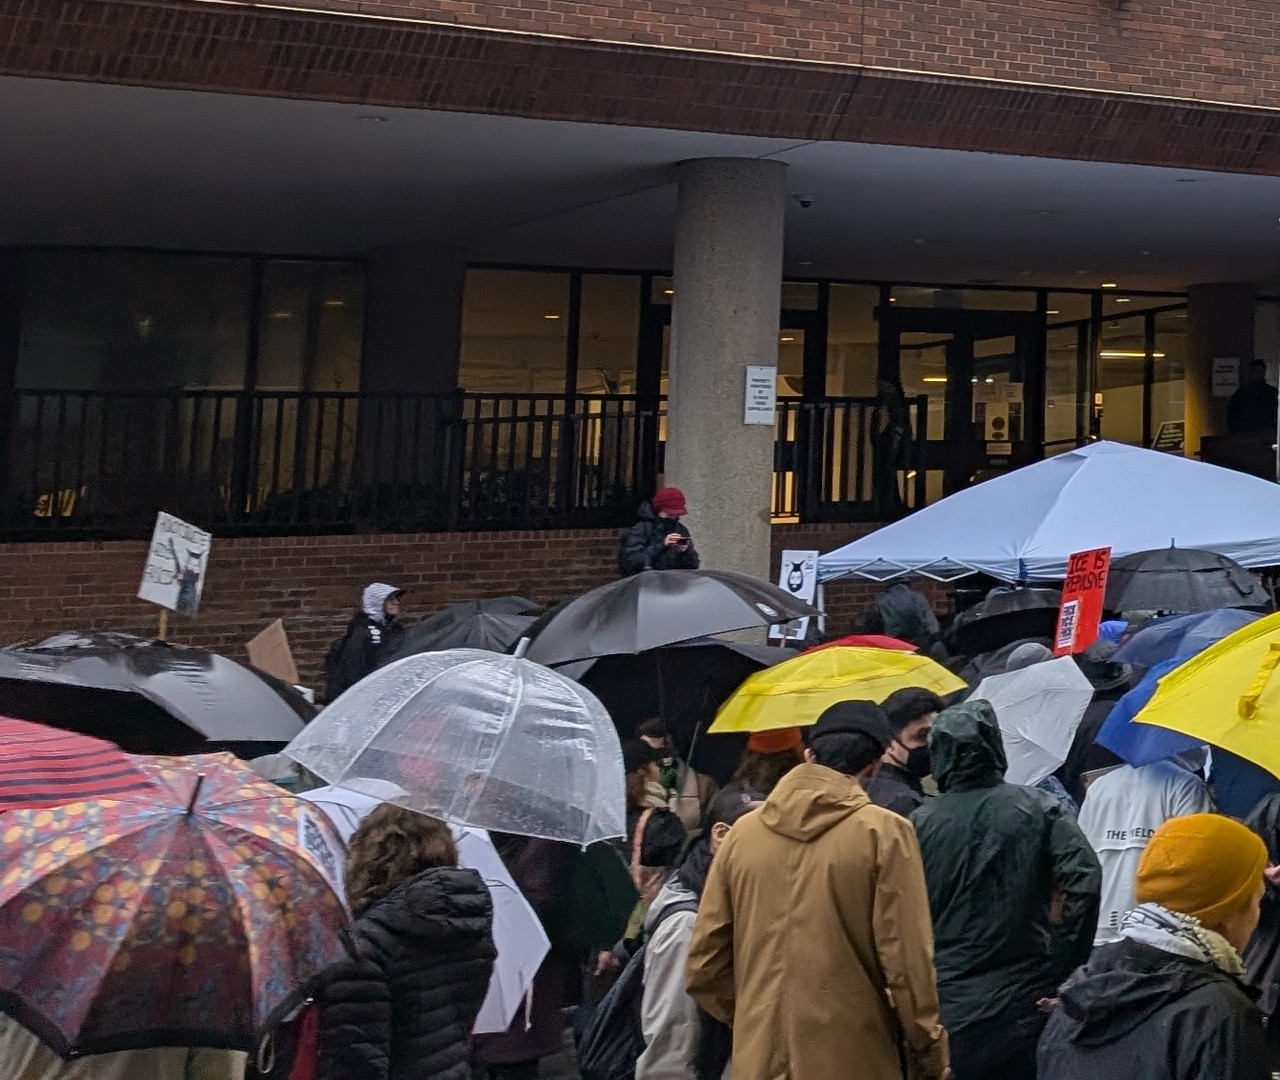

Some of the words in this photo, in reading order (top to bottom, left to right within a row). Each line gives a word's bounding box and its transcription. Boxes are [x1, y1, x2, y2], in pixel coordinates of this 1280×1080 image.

[1068, 553, 1089, 575] ICE
[1093, 550, 1107, 570] IS
[1106, 829, 1127, 841] THE
